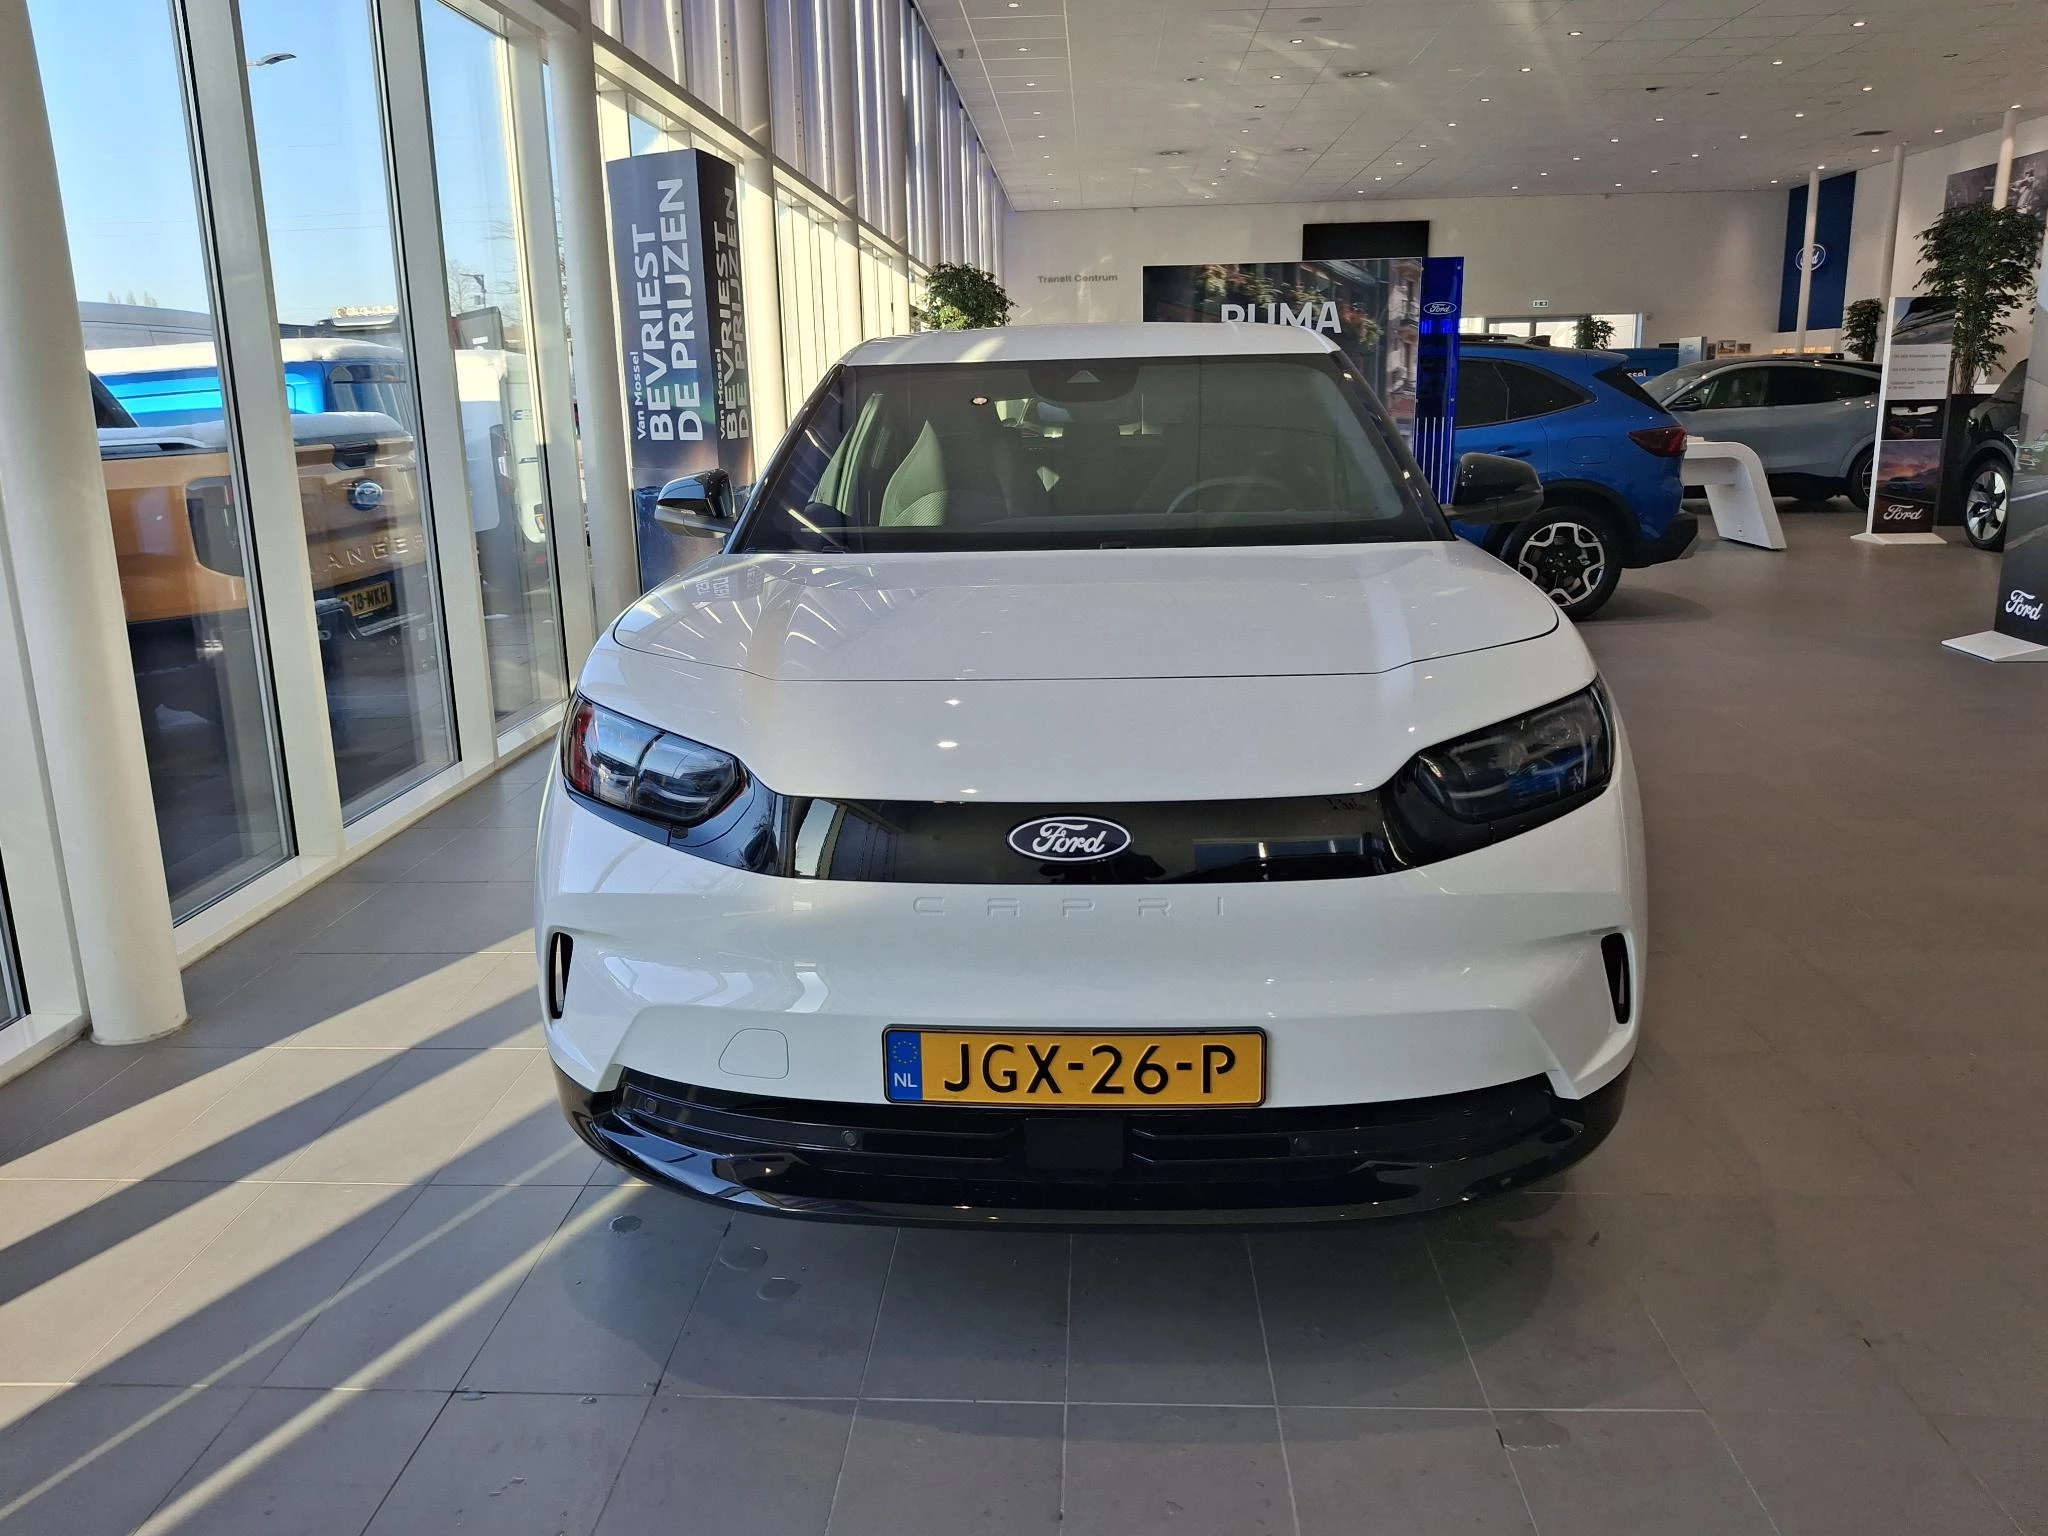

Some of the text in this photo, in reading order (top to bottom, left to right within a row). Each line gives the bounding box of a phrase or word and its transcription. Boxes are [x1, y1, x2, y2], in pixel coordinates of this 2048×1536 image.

[1037, 274, 1118, 283] Transit Centrum
[632, 223, 674, 441] BEVRIEST
[657, 178, 704, 441] DE PRIJZEN
[714, 221, 739, 440] BEVRIEST
[724, 187, 750, 439] DE PRIJZEN
[1430, 303, 1451, 313] Ford
[630, 351, 646, 440] Van Mossel
[714, 349, 727, 440] Van Mossel
[1883, 504, 1923, 521] Ford
[2005, 589, 2044, 621] Ford
[1032, 822, 1107, 854] Ford
[913, 896, 1225, 917] CAPRI
[894, 1042, 1237, 1095] NL JGX-26-P
